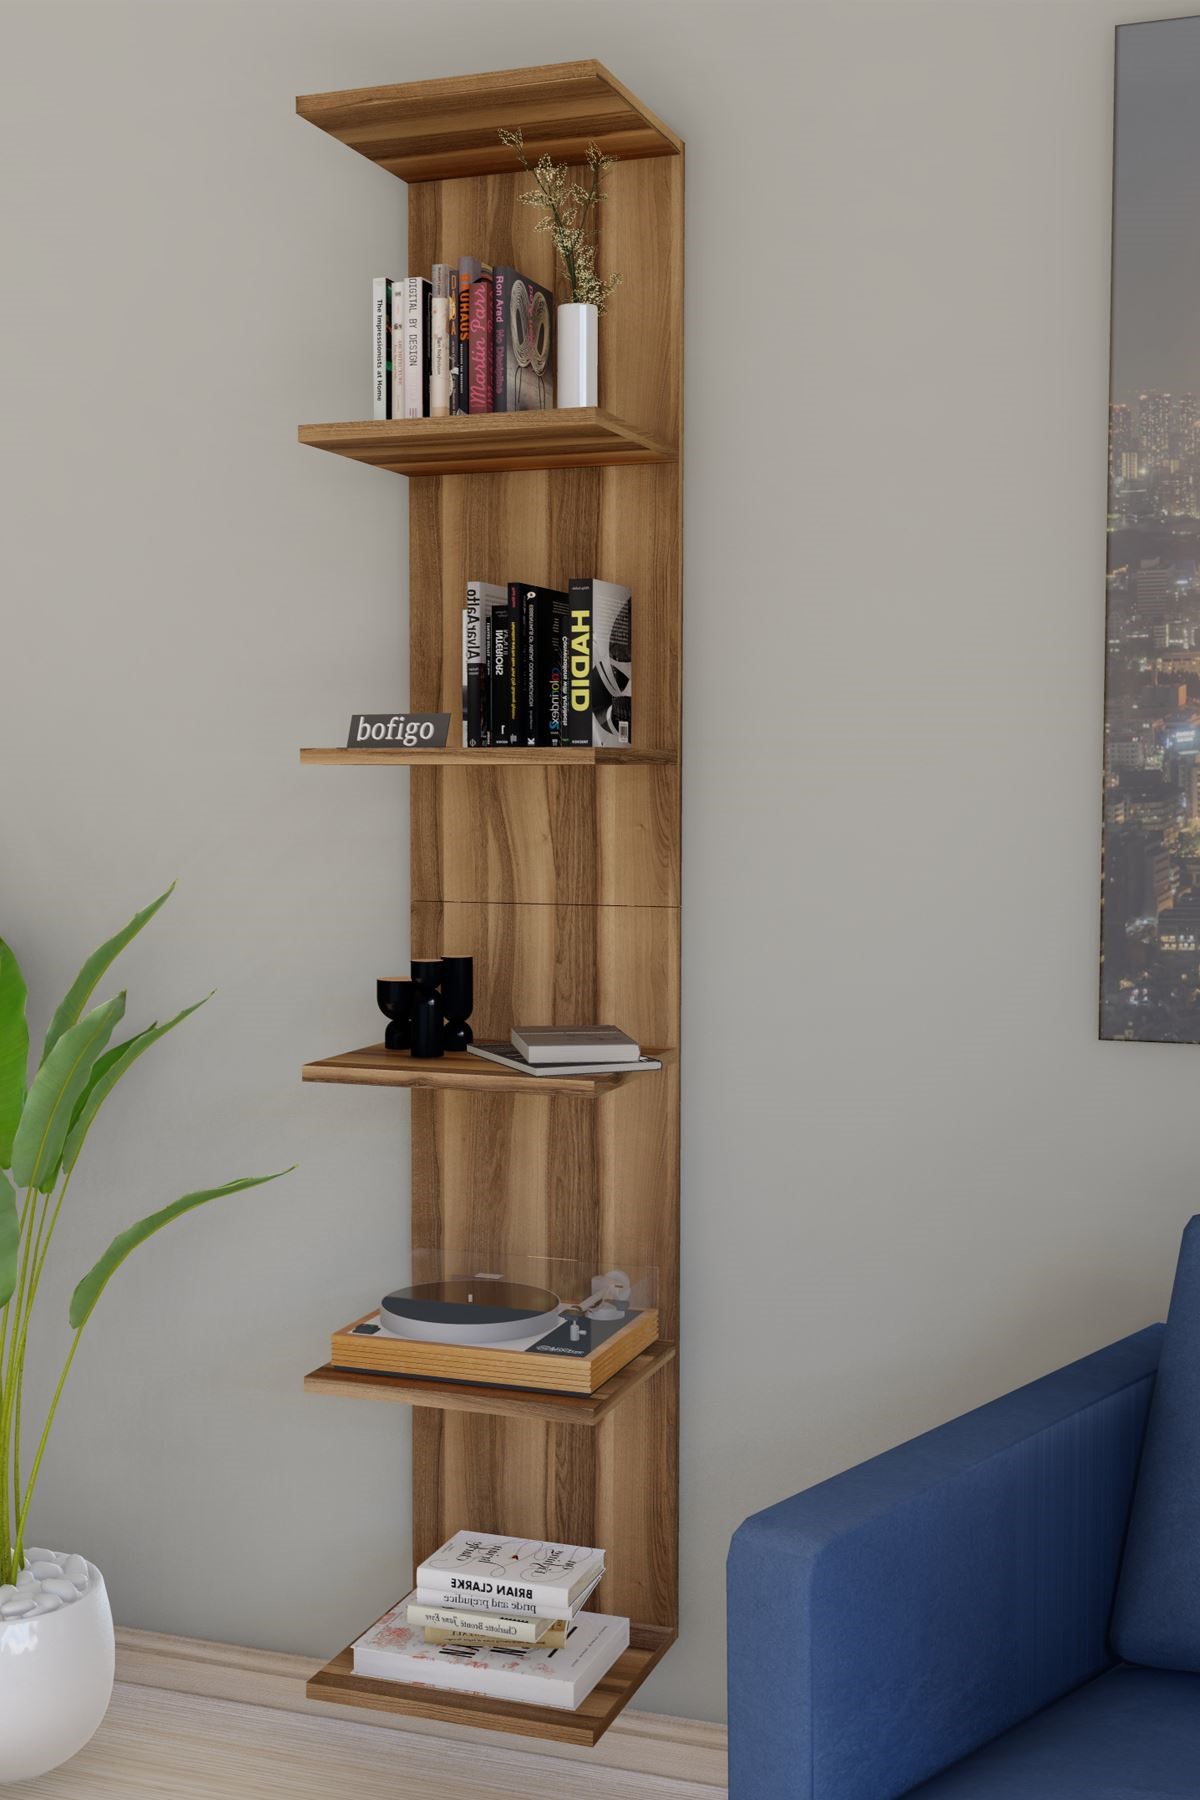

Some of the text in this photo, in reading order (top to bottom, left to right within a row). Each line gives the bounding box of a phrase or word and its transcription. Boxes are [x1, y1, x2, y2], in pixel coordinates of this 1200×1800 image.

[408, 278, 418, 367] DIGITAL BY DESIGN
[459, 272, 470, 342] BAUHAUS
[496, 276, 504, 323] Ron Arad
[376, 370, 382, 379] at
[470, 284, 486, 408] Martin Parr
[356, 716, 435, 748] bofigo
